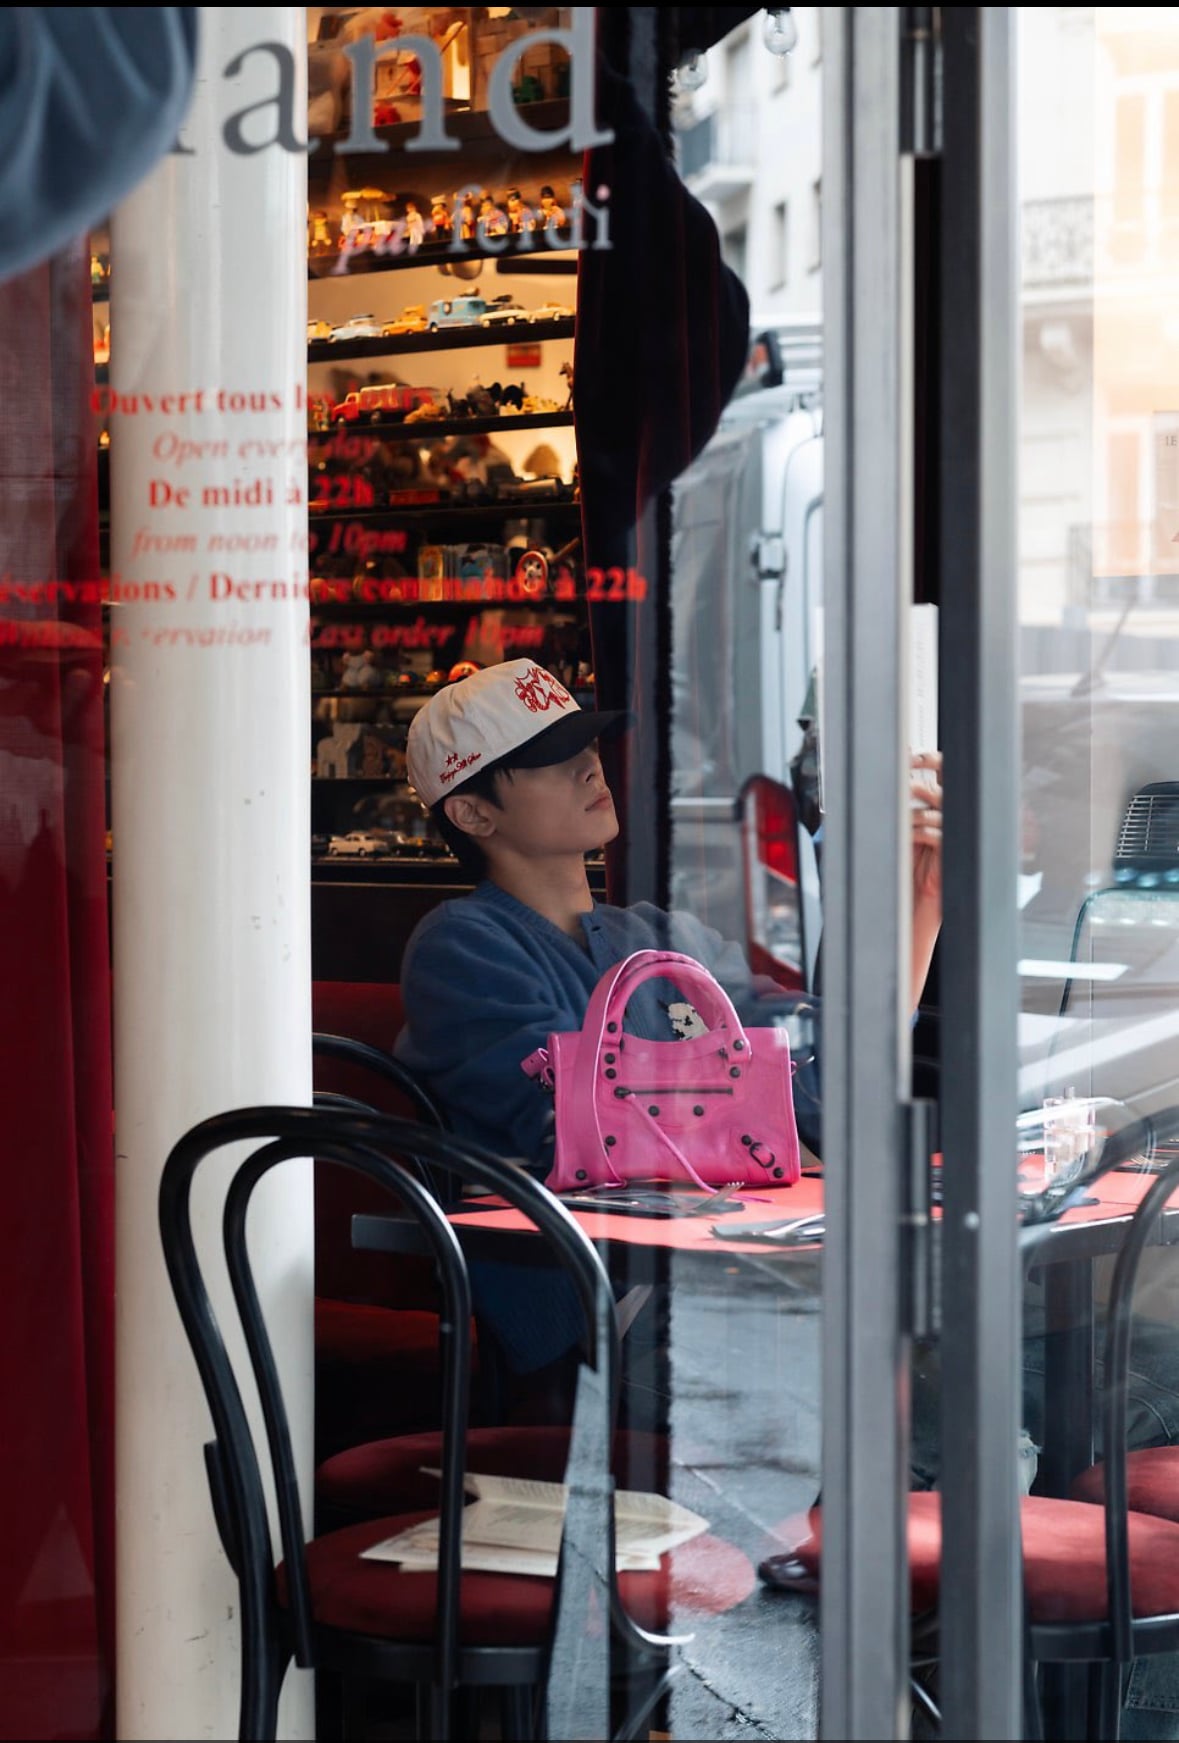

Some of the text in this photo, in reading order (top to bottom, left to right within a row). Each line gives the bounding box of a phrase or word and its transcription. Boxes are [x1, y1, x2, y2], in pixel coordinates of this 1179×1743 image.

[168, 8, 614, 156] and
[89, 384, 203, 417] Ouvert
[217, 388, 282, 414] tous
[152, 432, 229, 470] Open
[149, 478, 190, 509] De
[203, 478, 273, 507] midi
[311, 475, 374, 507] 22h
[129, 526, 199, 562] from
[207, 532, 280, 556] noon
[328, 522, 408, 561] 10pm
[586, 566, 648, 603] 22h
[464, 615, 545, 656] 10pm
